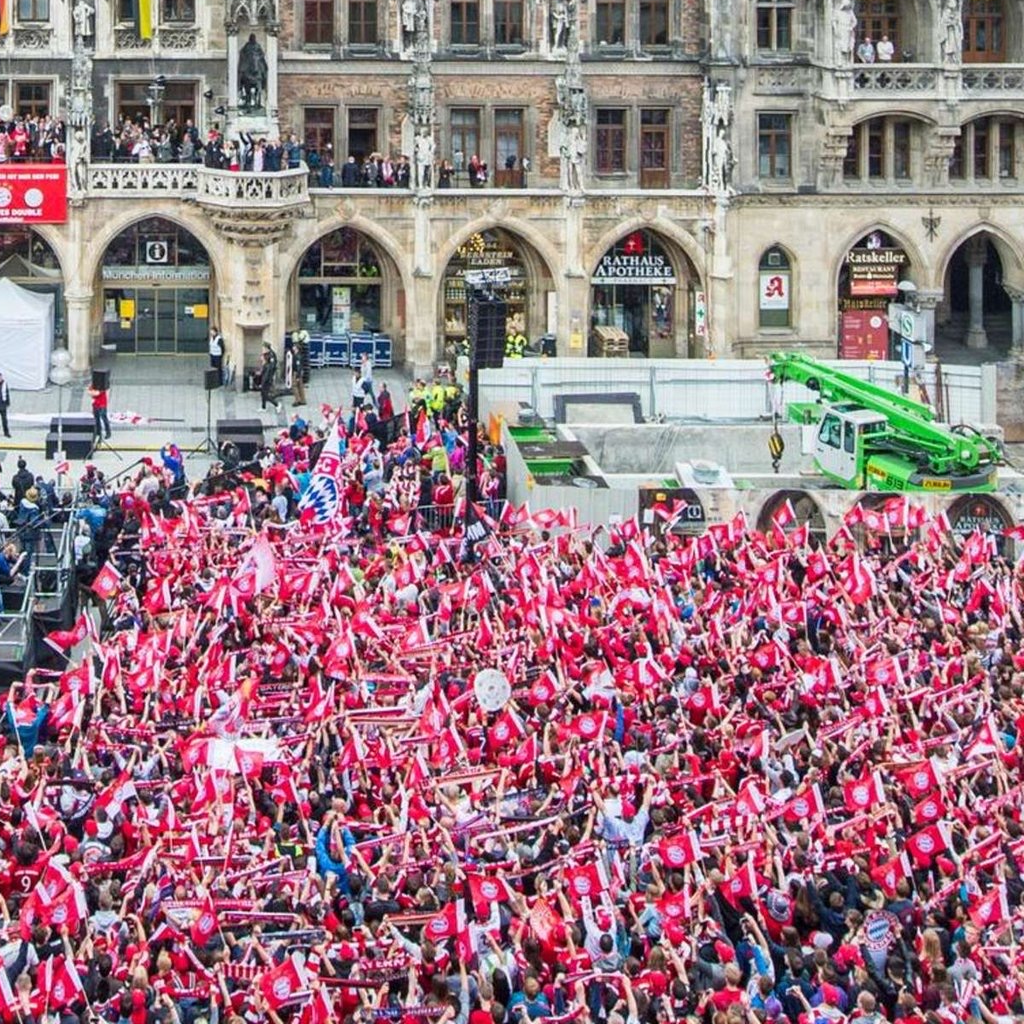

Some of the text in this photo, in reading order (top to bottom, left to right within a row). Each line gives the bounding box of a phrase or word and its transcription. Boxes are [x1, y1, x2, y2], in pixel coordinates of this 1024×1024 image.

[11, 208, 43, 216] DOUBLE
[603, 256, 664, 266] RATHAUS
[845, 250, 906, 263] Ratskeller
[596, 265, 672, 277] APOTHEKE
[902, 316, 912, 334] S
[21, 876, 31, 893] 9
